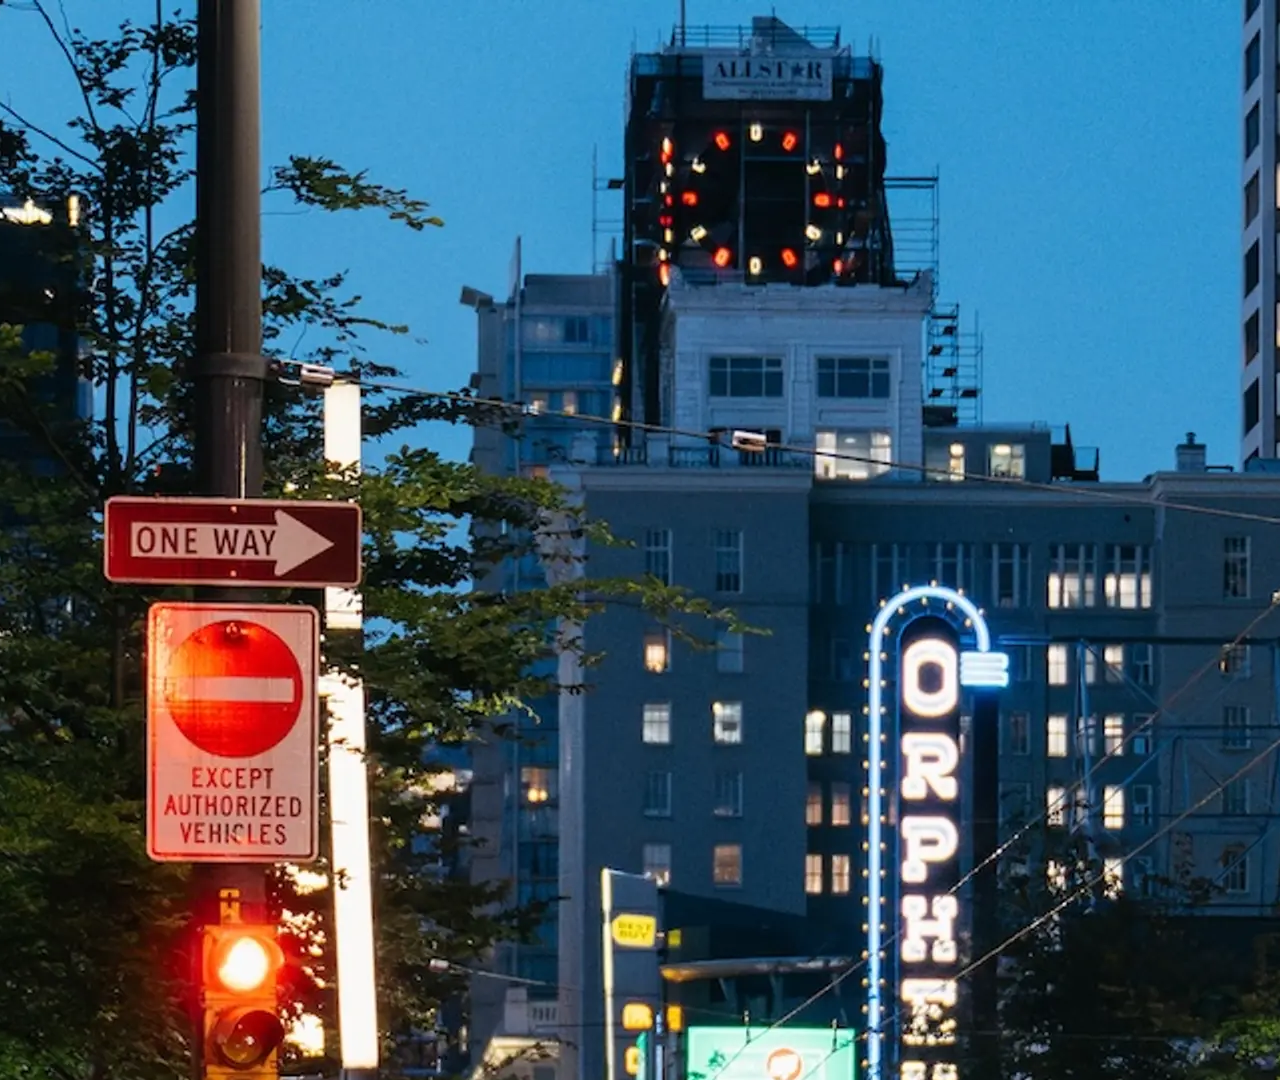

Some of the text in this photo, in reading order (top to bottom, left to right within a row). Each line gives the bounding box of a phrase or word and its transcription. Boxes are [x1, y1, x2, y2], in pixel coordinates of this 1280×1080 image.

[136, 526, 276, 556] ONE WAY
[191, 767, 274, 790] EXCEPT
[164, 794, 302, 818] AUTHORIZED
[179, 822, 287, 846] VEHICLES
